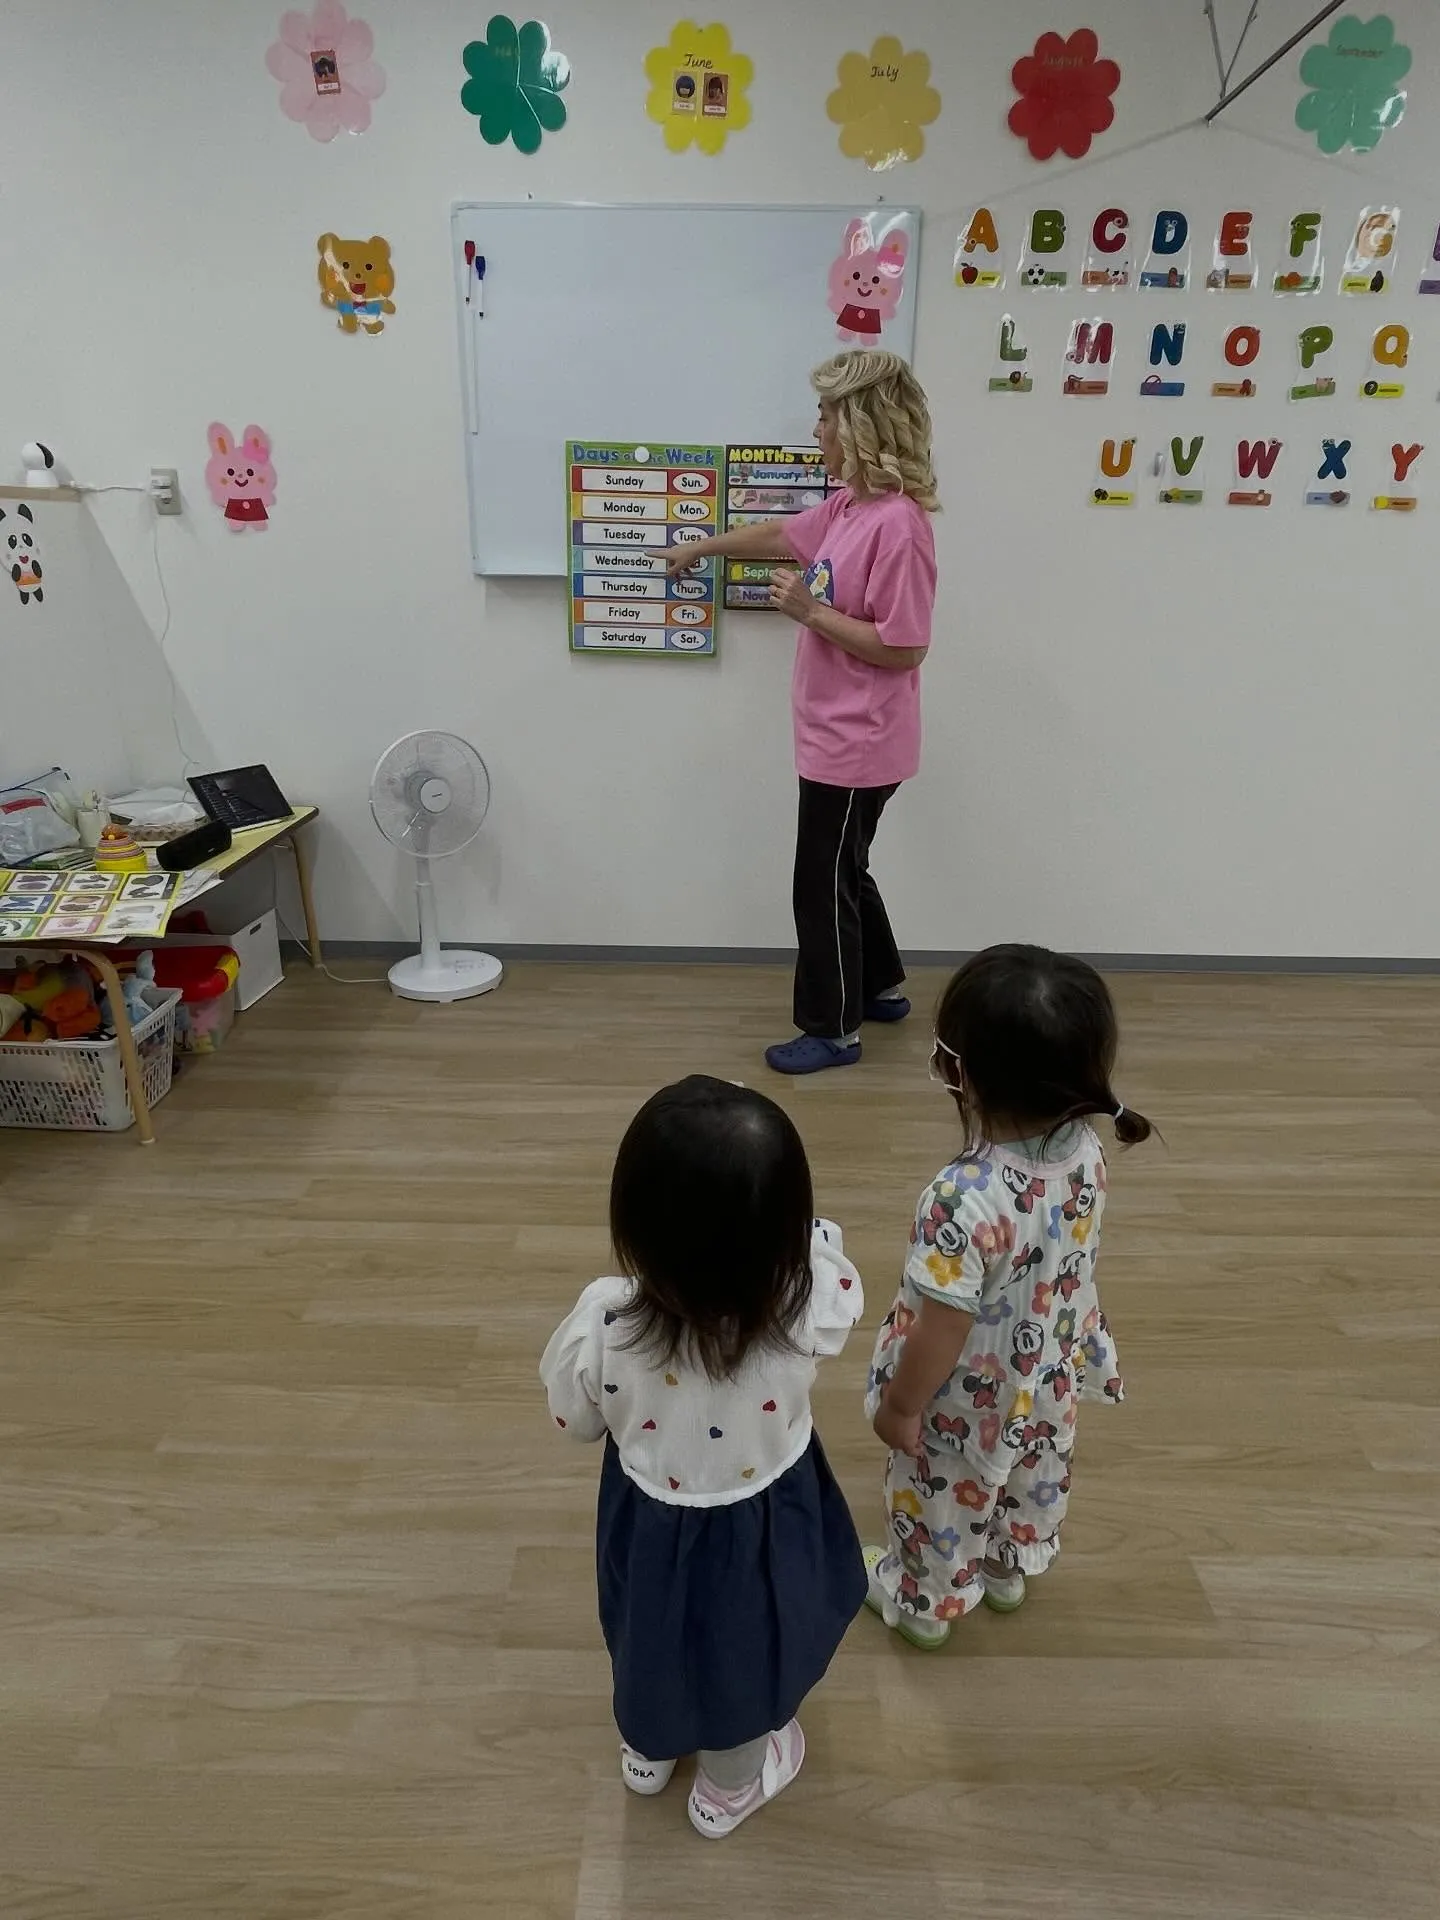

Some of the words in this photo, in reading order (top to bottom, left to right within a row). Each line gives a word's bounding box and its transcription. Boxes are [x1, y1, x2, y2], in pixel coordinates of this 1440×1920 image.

[684, 54, 713, 69] June
[870, 65, 899, 82] July
[964, 208, 998, 252] A
[1031, 210, 1064, 252] B
[1093, 209, 1127, 252] C
[1153, 212, 1187, 254] D
[1220, 212, 1252, 255] E
[1290, 214, 1320, 256] F
[1000, 320, 1027, 361] L
[1070, 322, 1113, 363] M
[1150, 325, 1184, 365] N
[1225, 327, 1259, 366] O
[1301, 326, 1333, 368] P
[1373, 325, 1408, 367] Q
[573, 444, 620, 462] Days
[665, 448, 714, 465] Week
[729, 449, 795, 463] MONTHS
[1101, 440, 1134, 477] U
[1171, 437, 1204, 476] V
[1238, 441, 1278, 478] W
[1318, 441, 1349, 479] X
[1392, 444, 1421, 481] Y
[605, 475, 644, 490] Sunday
[682, 477, 702, 487] Sun.
[753, 470, 801, 482] January
[604, 502, 645, 516] Monday
[680, 504, 704, 514] Mon.
[604, 529, 645, 542] Tuesday
[594, 555, 654, 569] Wednesday
[601, 581, 647, 595] Thursday
[609, 607, 640, 620] Friday
[682, 609, 697, 619] Fri.
[601, 631, 647, 645] Saturday
[680, 634, 699, 643] Sat.
